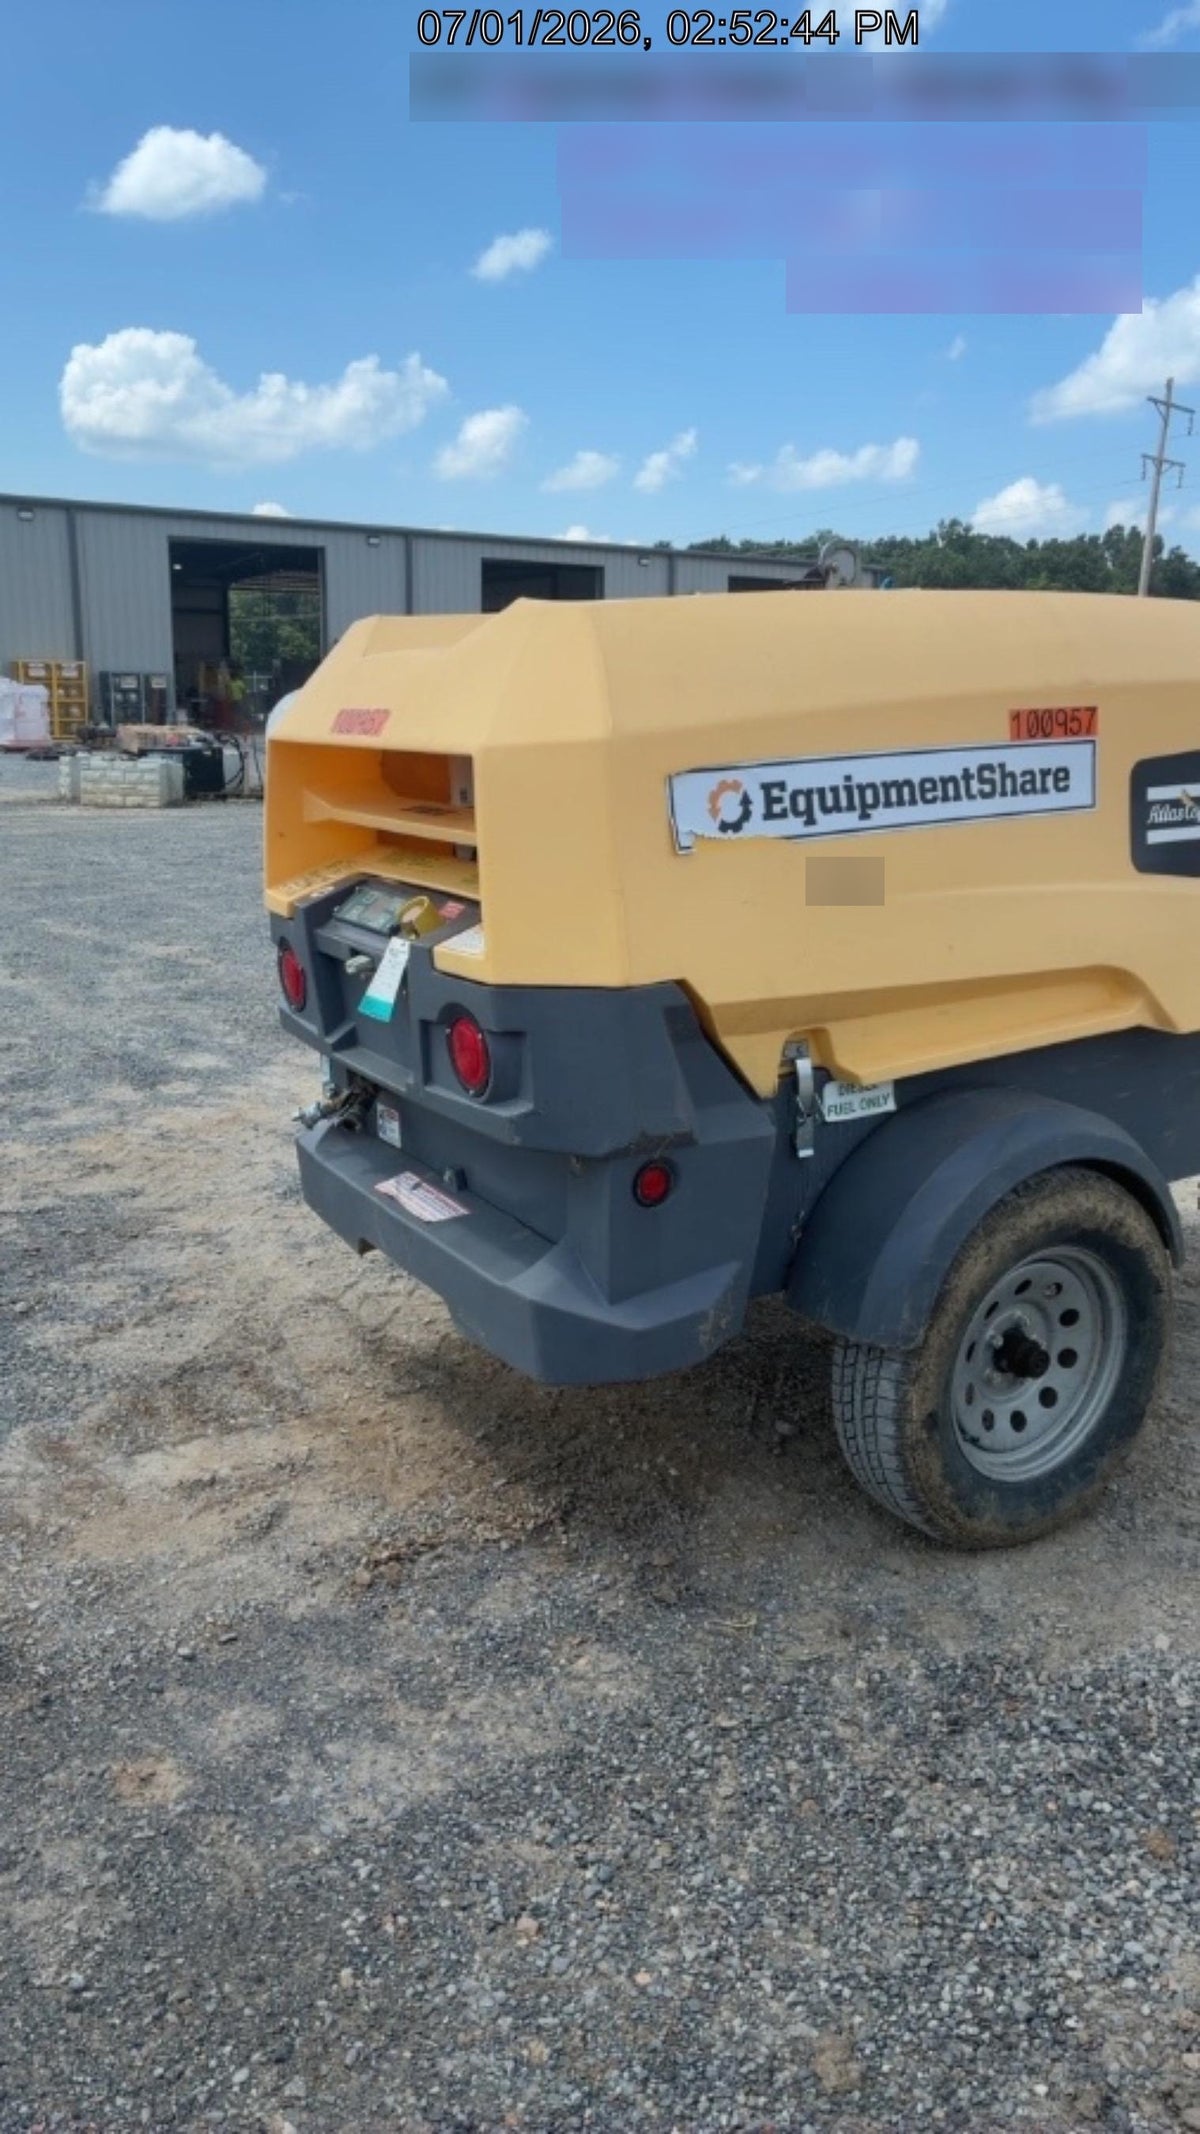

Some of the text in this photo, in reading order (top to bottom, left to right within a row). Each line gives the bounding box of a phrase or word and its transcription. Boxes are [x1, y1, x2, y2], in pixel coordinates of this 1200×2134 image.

[1010, 707, 1096, 739] 100957
[761, 762, 1070, 828] EquipmentShare
[827, 1092, 891, 1118] FUEL ONLY
